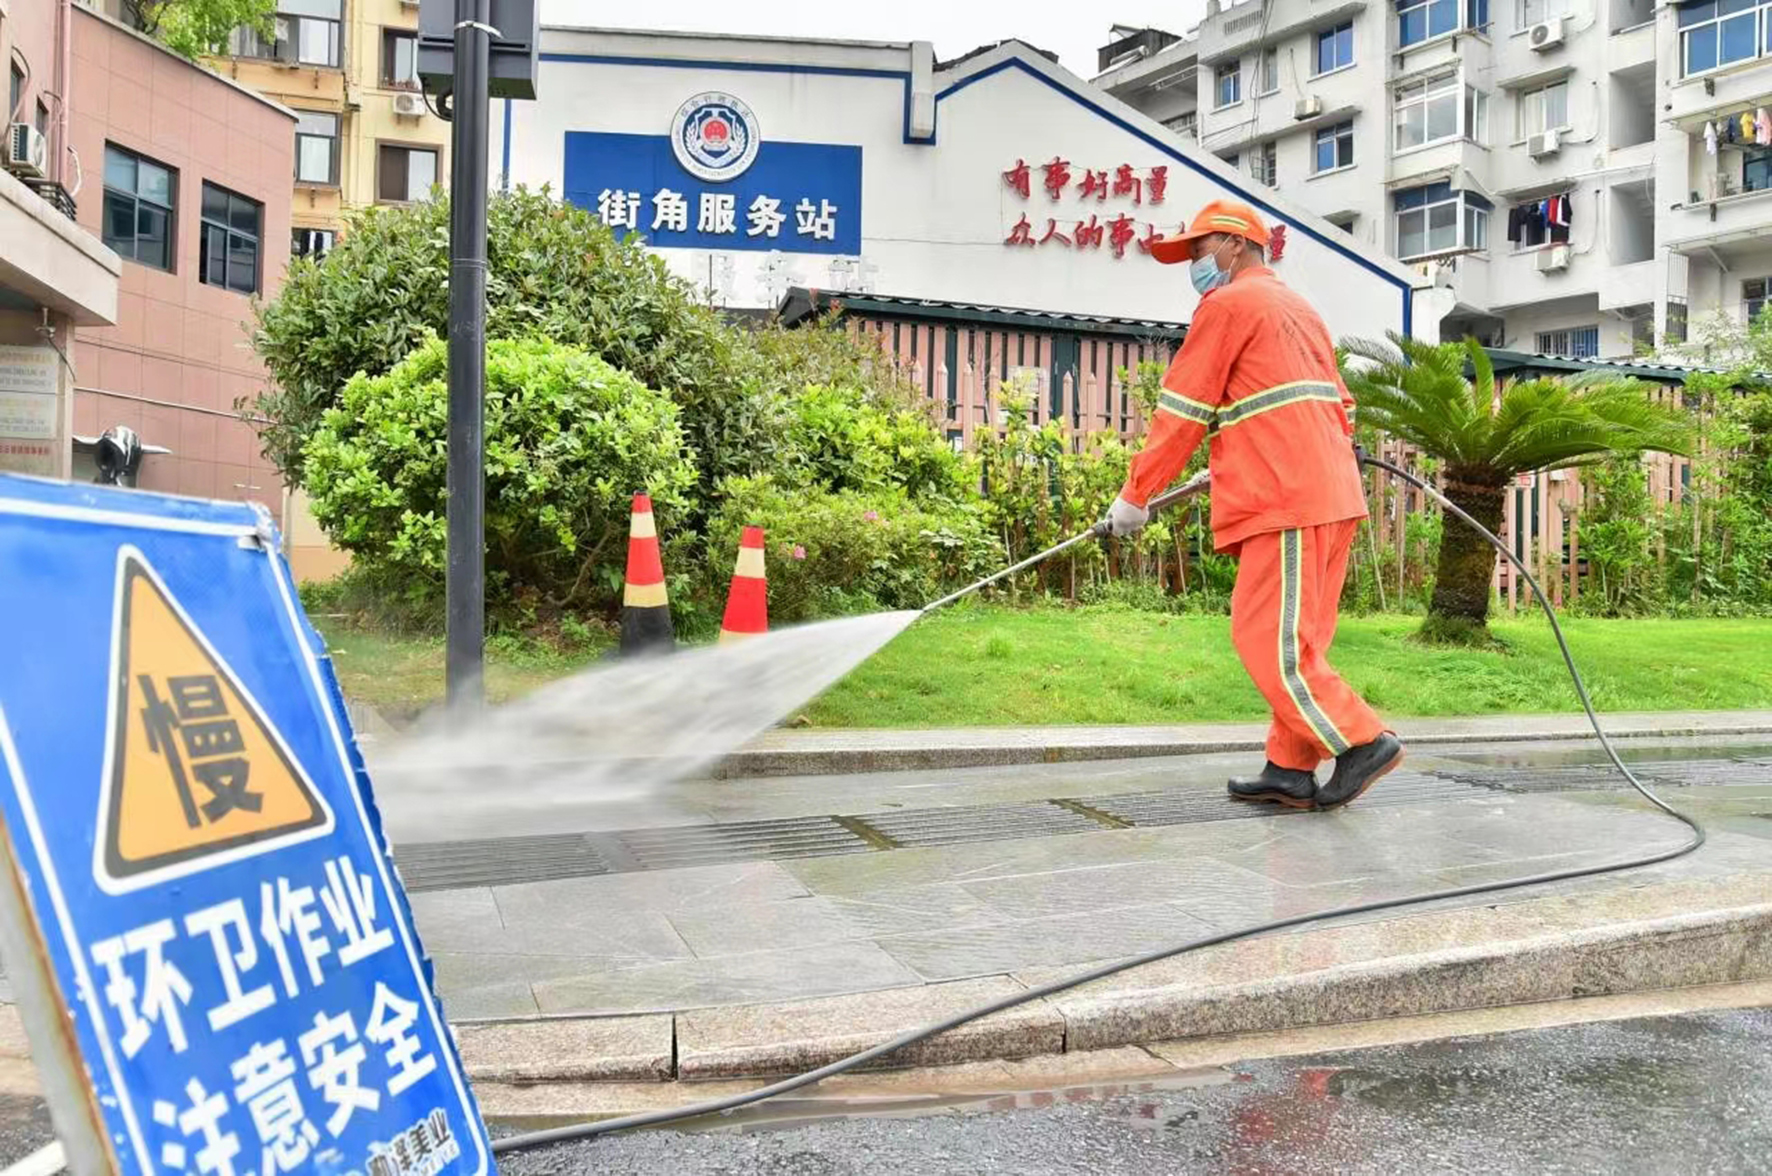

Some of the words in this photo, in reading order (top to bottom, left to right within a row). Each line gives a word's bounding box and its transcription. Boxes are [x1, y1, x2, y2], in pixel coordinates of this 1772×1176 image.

[598, 188, 837, 240] 街角服务站
[1003, 156, 1168, 205] 有事好商量
[137, 674, 264, 829] 慢
[90, 856, 395, 1058] 环卫作业
[153, 981, 438, 1176] 注意安全
